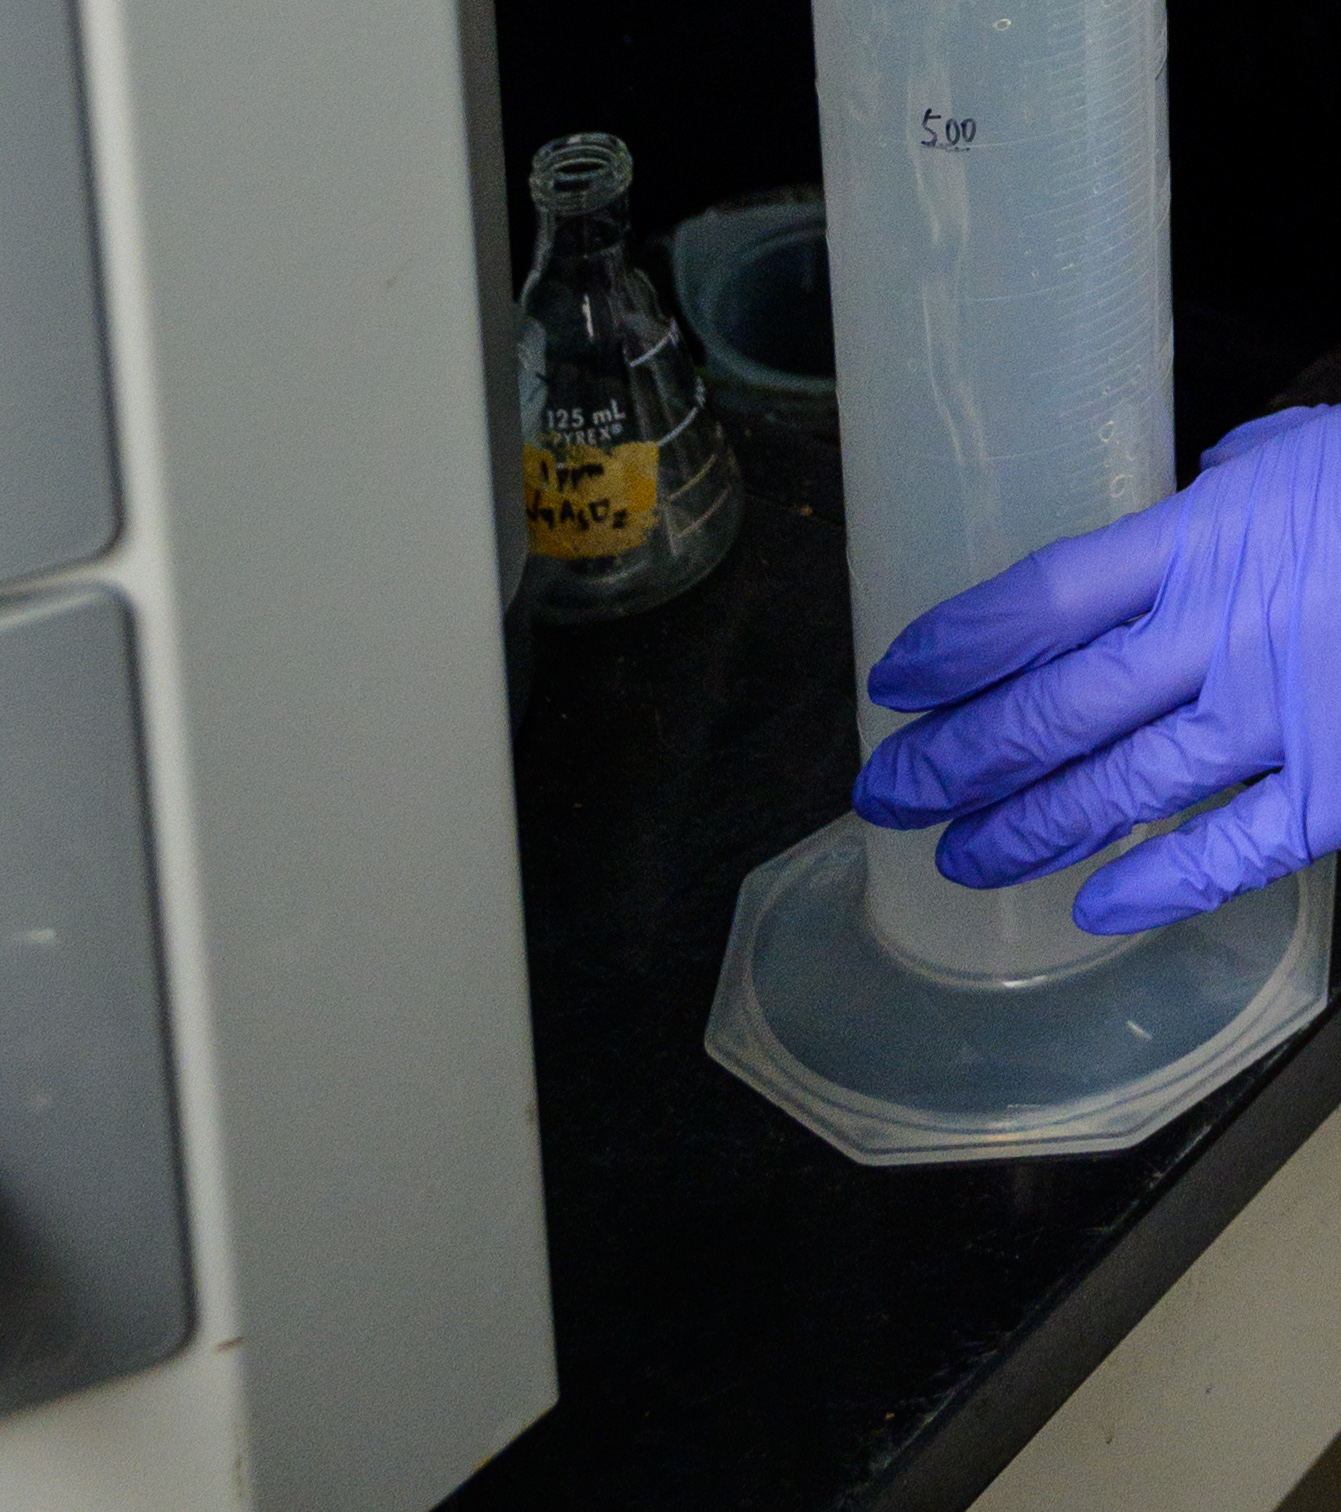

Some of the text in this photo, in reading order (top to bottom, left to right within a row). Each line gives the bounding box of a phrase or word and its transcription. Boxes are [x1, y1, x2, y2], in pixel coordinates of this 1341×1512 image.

[920, 107, 978, 148] 500
[547, 398, 627, 430] 125 mL
